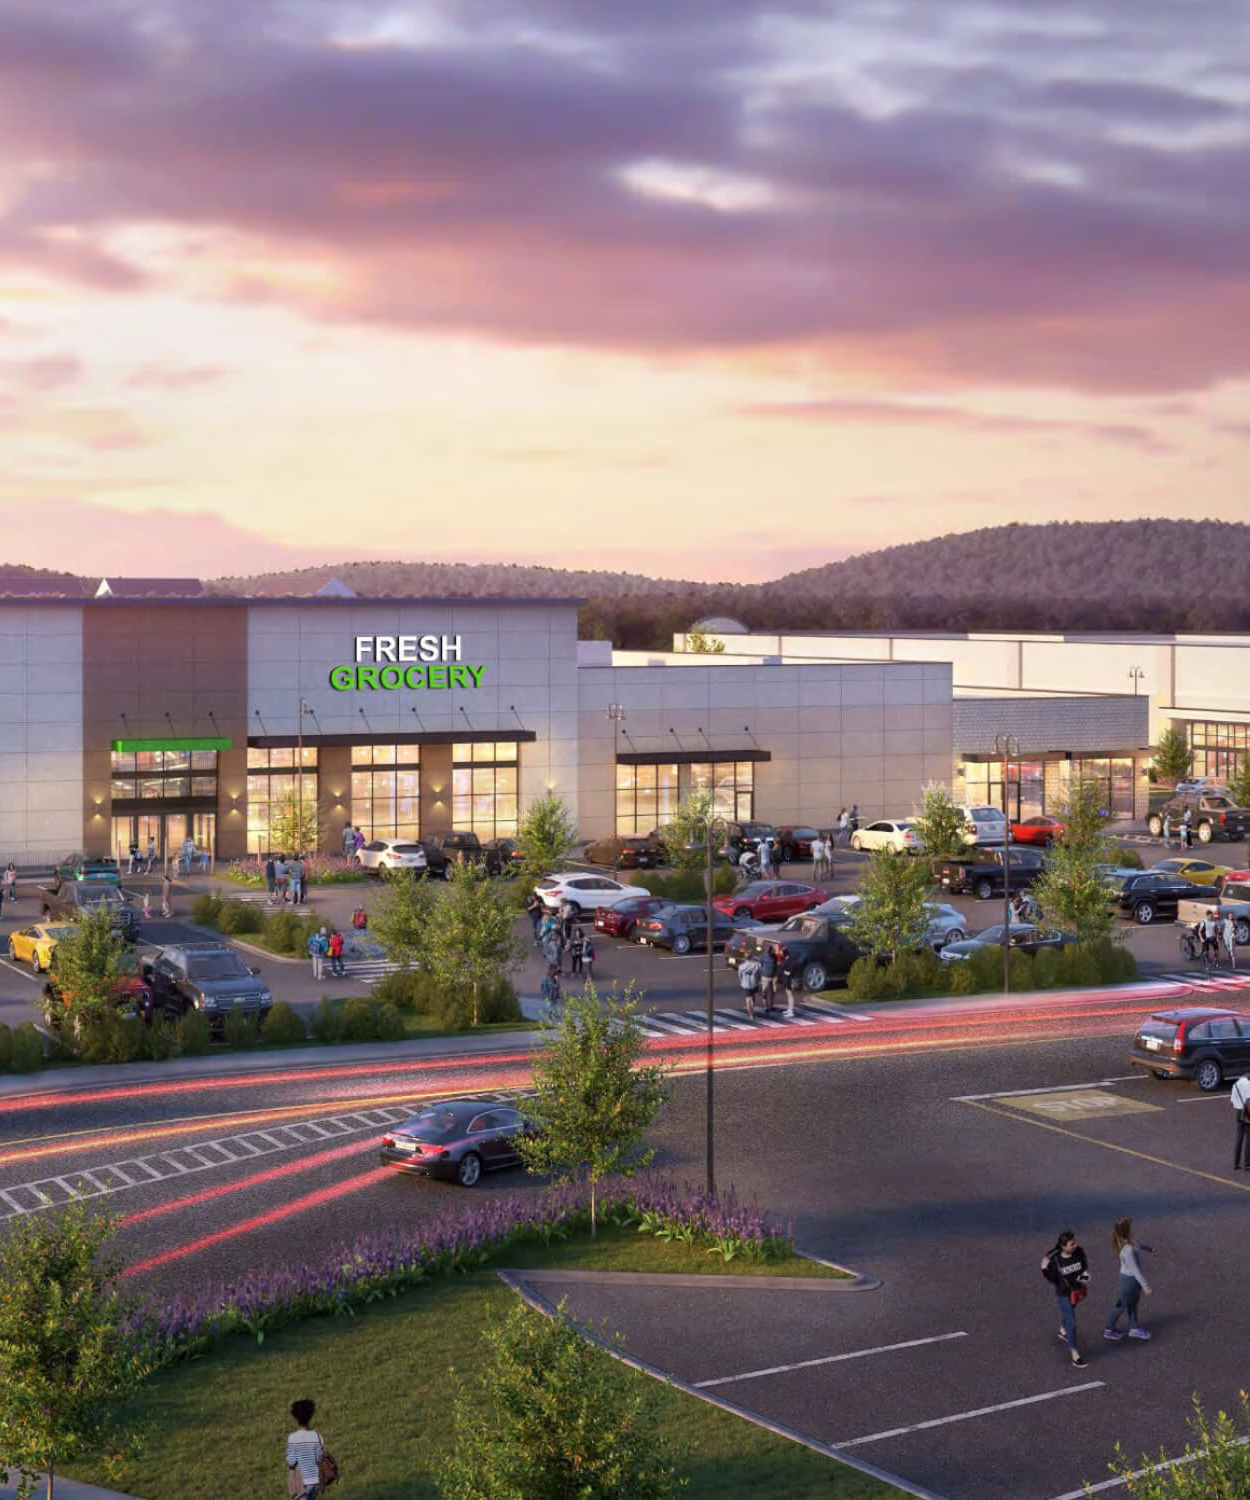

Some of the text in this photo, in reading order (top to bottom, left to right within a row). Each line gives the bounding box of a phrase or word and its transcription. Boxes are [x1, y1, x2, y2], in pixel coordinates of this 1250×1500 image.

[354, 635, 462, 662] FRESH
[330, 665, 487, 691] GROCERY
[1033, 1096, 1117, 1111] STOP
